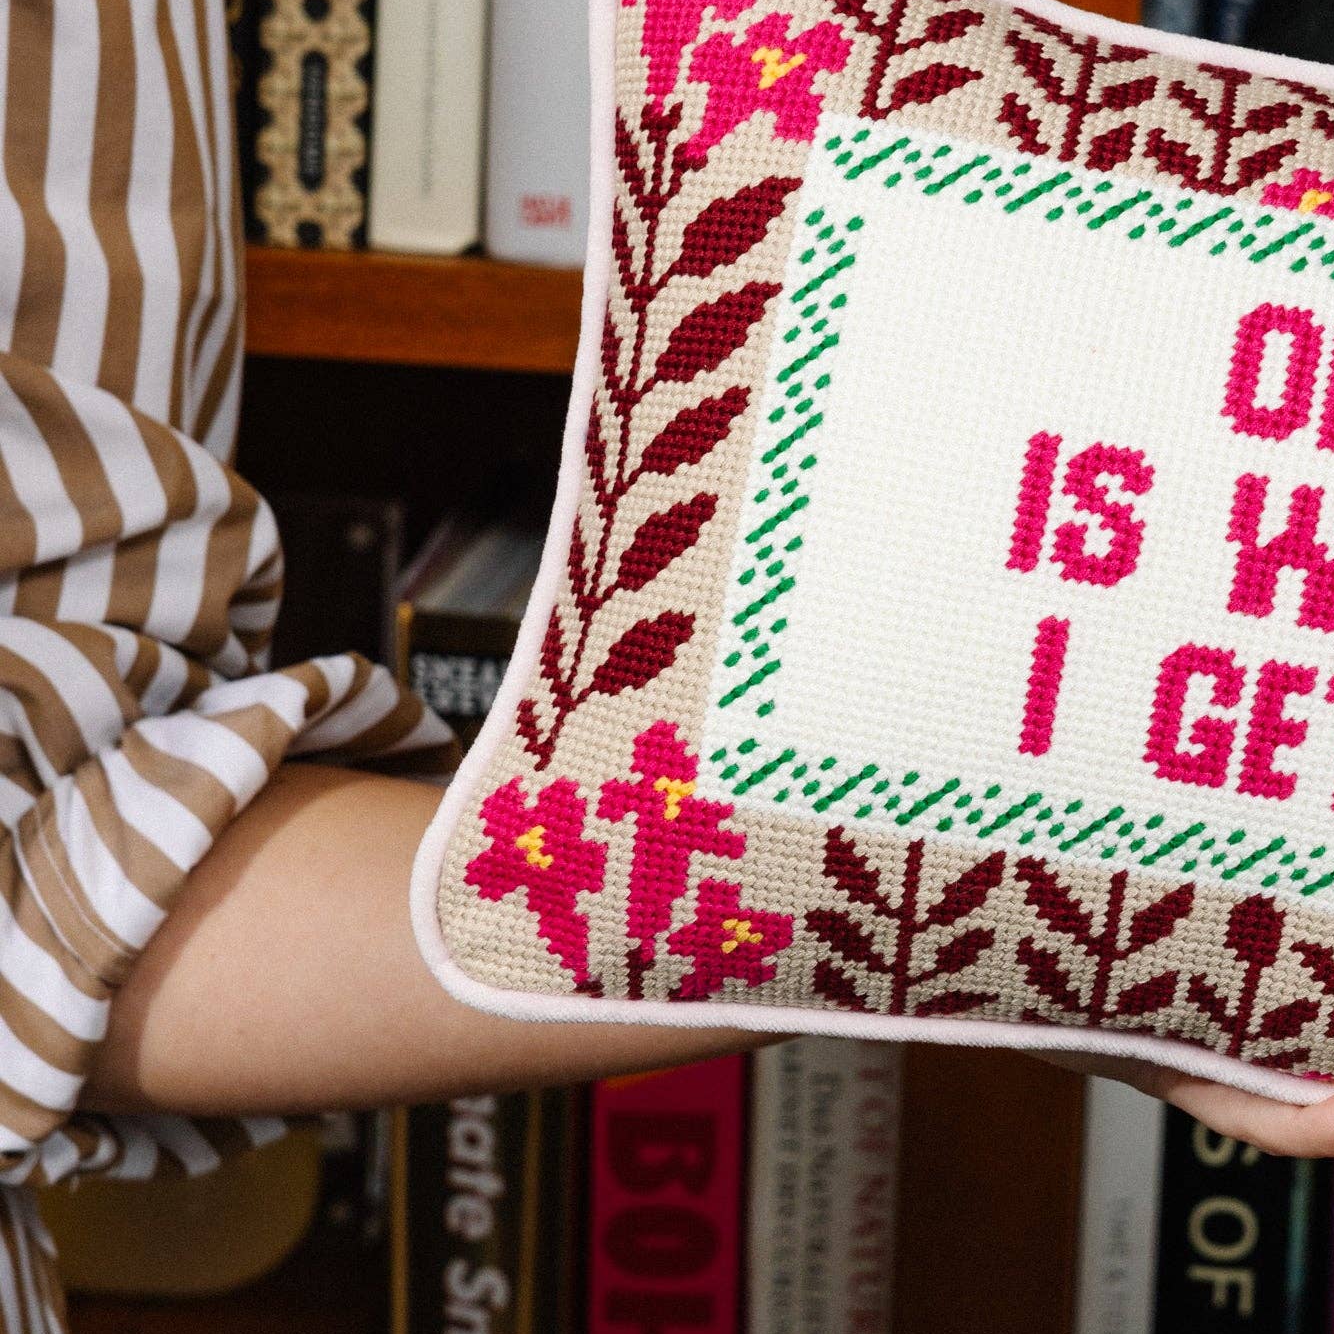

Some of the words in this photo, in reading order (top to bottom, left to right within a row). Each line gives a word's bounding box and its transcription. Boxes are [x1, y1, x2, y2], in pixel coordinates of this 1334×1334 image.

[1005, 431, 1155, 588] IS
[1018, 614, 1072, 756] I
[1186, 1195, 1260, 1318] OF
